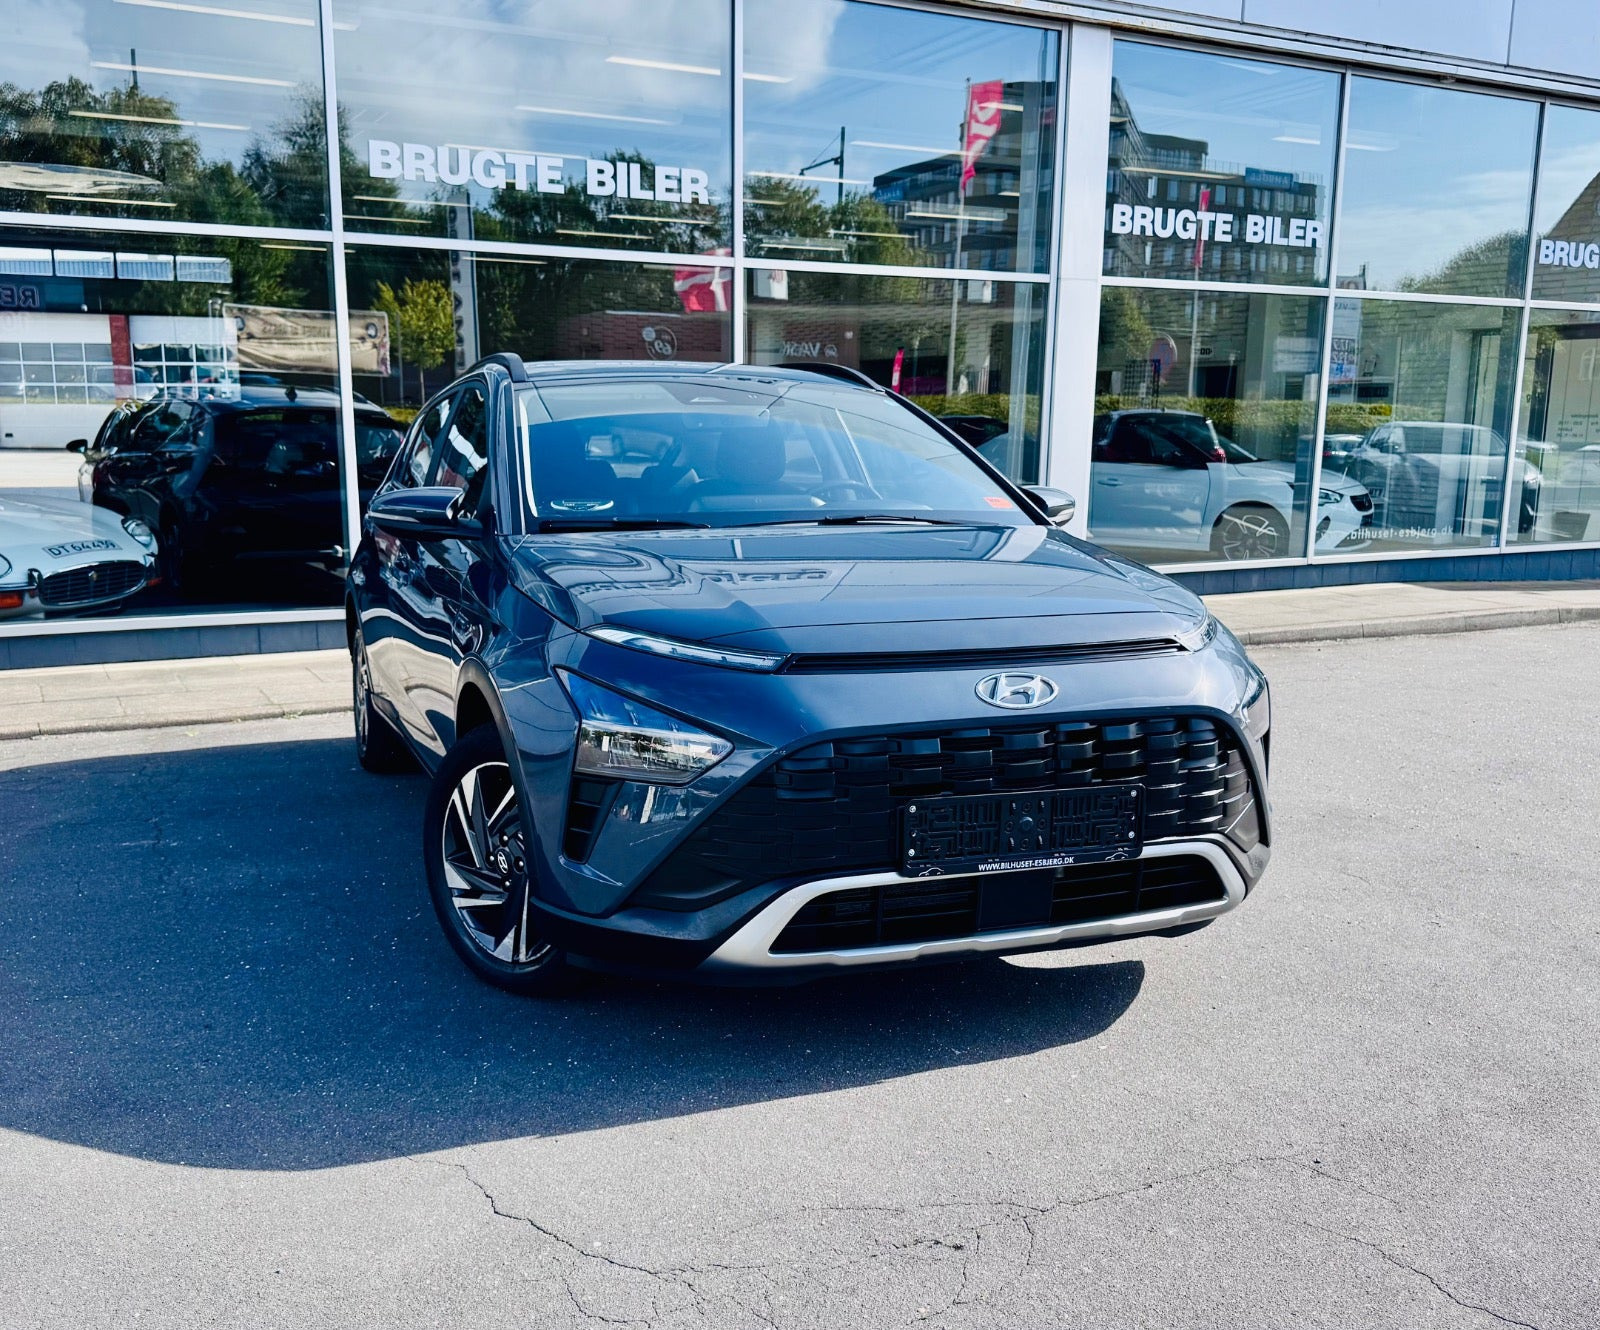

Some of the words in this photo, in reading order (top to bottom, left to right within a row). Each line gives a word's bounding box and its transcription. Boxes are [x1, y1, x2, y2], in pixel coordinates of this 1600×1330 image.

[368, 139, 565, 194] BRUGTE
[586, 158, 709, 205] BILER
[1111, 203, 1233, 242] BRUGTE
[1245, 214, 1324, 248] BILER
[1538, 239, 1600, 269] BRUG
[978, 856, 1074, 872] WWW.BILHUSET-ESBJERG.DK
